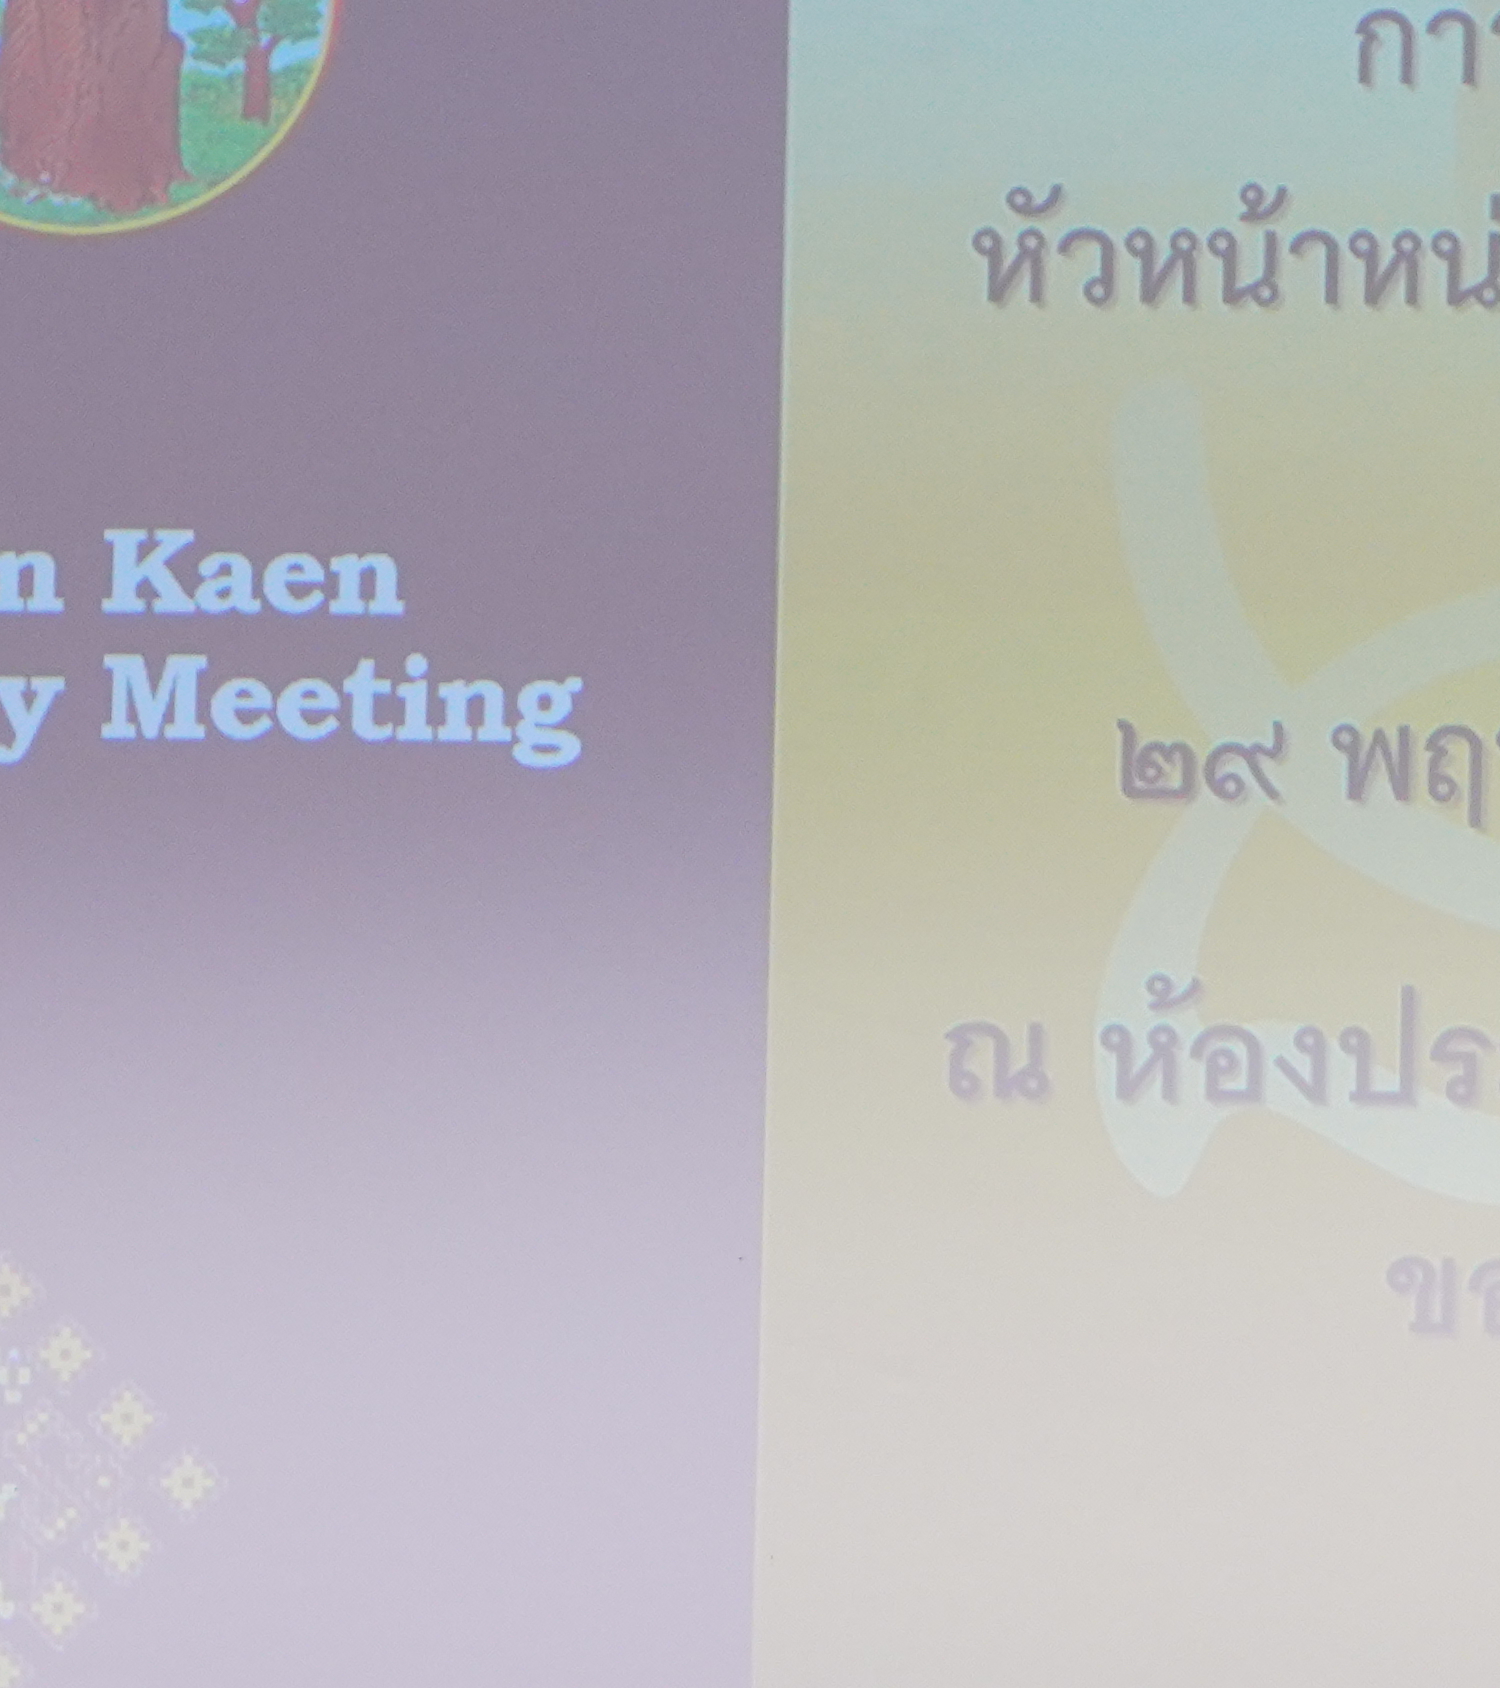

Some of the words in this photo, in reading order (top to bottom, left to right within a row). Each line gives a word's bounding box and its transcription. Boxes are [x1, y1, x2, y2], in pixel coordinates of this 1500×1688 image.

[101, 528, 405, 615] Kaen
[101, 653, 583, 767] Meeting
[1115, 712, 1290, 805] ๒๙
[942, 1019, 1053, 1104] ณ
